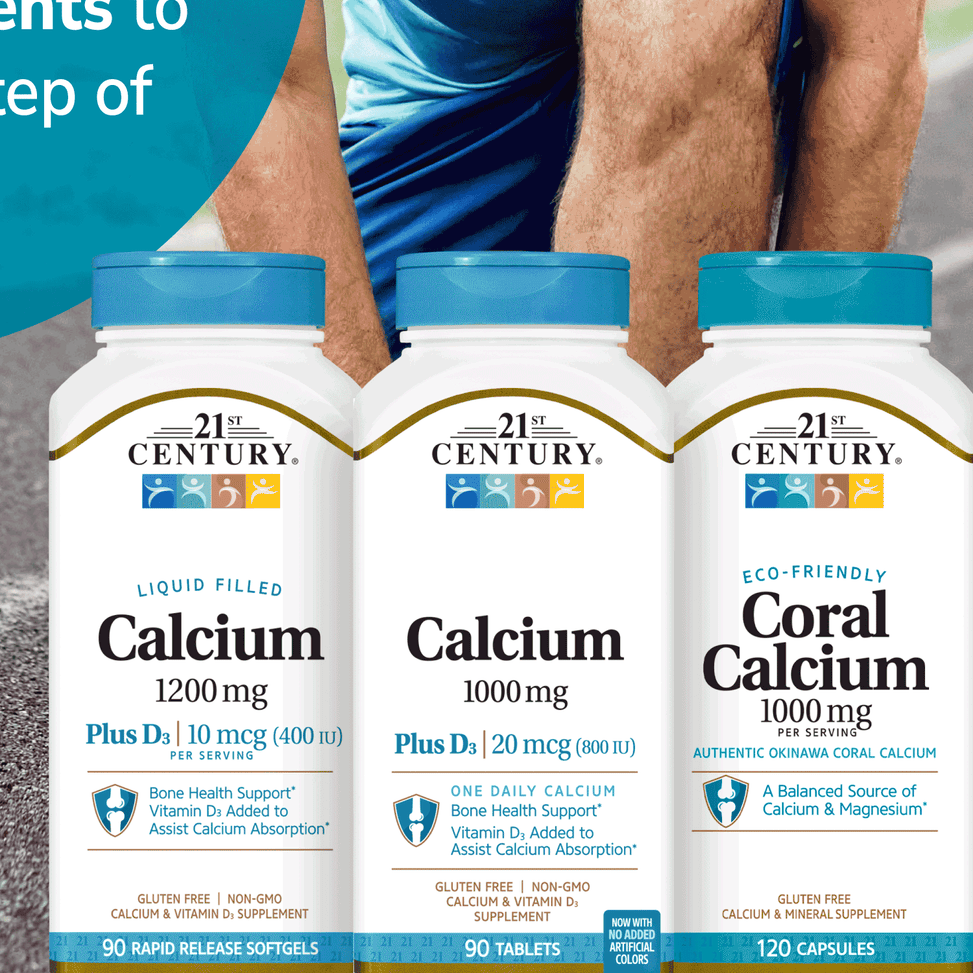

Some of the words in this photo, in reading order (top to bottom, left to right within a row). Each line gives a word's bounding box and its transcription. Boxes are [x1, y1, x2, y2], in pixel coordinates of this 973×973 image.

[742, 564, 887, 584] ECO-FRIENDLY
[137, 578, 205, 598] LIQUID
[215, 577, 282, 597] FILLED
[742, 588, 890, 639] Coral
[98, 611, 326, 662] Calcium
[406, 614, 625, 662] Calcium
[702, 641, 930, 692] Calcium
[155, 678, 218, 703] 1200
[222, 684, 269, 711] mg
[463, 679, 521, 703] 1000
[525, 685, 569, 711] mg
[760, 698, 822, 723] 1000
[826, 704, 873, 731] mg
[85, 722, 138, 745] Plus
[187, 723, 211, 745] 10
[216, 728, 267, 751] mcg
[273, 726, 315, 748] (400
[319, 726, 343, 748] IU)
[777, 727, 800, 738] PER
[805, 728, 857, 738] SERVING
[394, 732, 445, 755] Plus
[491, 733, 518, 755] 20
[522, 738, 572, 762] mcg
[575, 737, 609, 758] (800
[612, 737, 636, 758] IU)
[692, 747, 765, 759] AUTHENTIC
[768, 746, 830, 759] OKINAWA
[832, 746, 876, 759] CORAL
[879, 746, 937, 759] CALCIUM
[170, 750, 193, 761] PER
[199, 750, 254, 761] SERVING
[149, 786, 185, 800] Bone
[189, 786, 233, 800] Health
[450, 784, 483, 797] ONE
[490, 784, 537, 797] DAILY
[544, 784, 615, 797] CALCIUM
[762, 784, 774, 798] A
[778, 783, 843, 798] Balanced
[847, 784, 897, 798] Source
[899, 783, 917, 798] of
[149, 804, 202, 818] Vitamin
[225, 804, 270, 818] Added
[273, 804, 289, 818] to
[451, 803, 487, 817] Bone
[491, 803, 537, 818] Health
[762, 801, 820, 816] Calcium
[824, 801, 836, 816] &
[148, 821, 189, 836] Assist
[192, 821, 246, 836] Calcium
[450, 825, 505, 840] Vitamin
[529, 825, 575, 840] Added
[579, 826, 595, 840] to
[450, 842, 492, 856] Assist
[495, 842, 551, 856] Calcium
[435, 881, 481, 892] GLUTEN
[485, 881, 513, 892] FREE
[532, 881, 591, 892] NON-GMO
[137, 893, 181, 904] GLUTEN
[184, 893, 211, 904] FREE
[227, 893, 282, 904] NON-GMO
[446, 896, 498, 907] CALCIUM
[502, 896, 511, 907] &
[513, 896, 562, 907] VITAMIN
[777, 893, 821, 905] GLUTEN
[824, 894, 851, 905] FREE
[110, 908, 159, 919] CALCIUM
[163, 908, 171, 919] &
[174, 908, 219, 919] VITAMIN
[237, 908, 309, 919] SUPPLEMENT
[474, 911, 551, 922] SUPPLEMENT
[722, 908, 770, 920] CALCIUM
[774, 908, 782, 920] &
[785, 908, 834, 920] MINERAL
[835, 908, 907, 920] SUPPLEMENT
[611, 917, 631, 928] NOW
[632, 917, 653, 927] WITH
[609, 929, 622, 940] NO
[624, 929, 656, 940] ADDED
[102, 938, 126, 957] 90
[131, 941, 175, 955] RAPID
[179, 941, 243, 956] RELEASE
[246, 941, 319, 956] SOFTGELS
[464, 939, 490, 958] 90
[495, 942, 561, 956] TABLETS
[609, 941, 655, 953] ARTIFICIAL
[757, 938, 791, 958] 120
[796, 941, 875, 956] CAPSULES
[615, 953, 649, 965] COLORS
